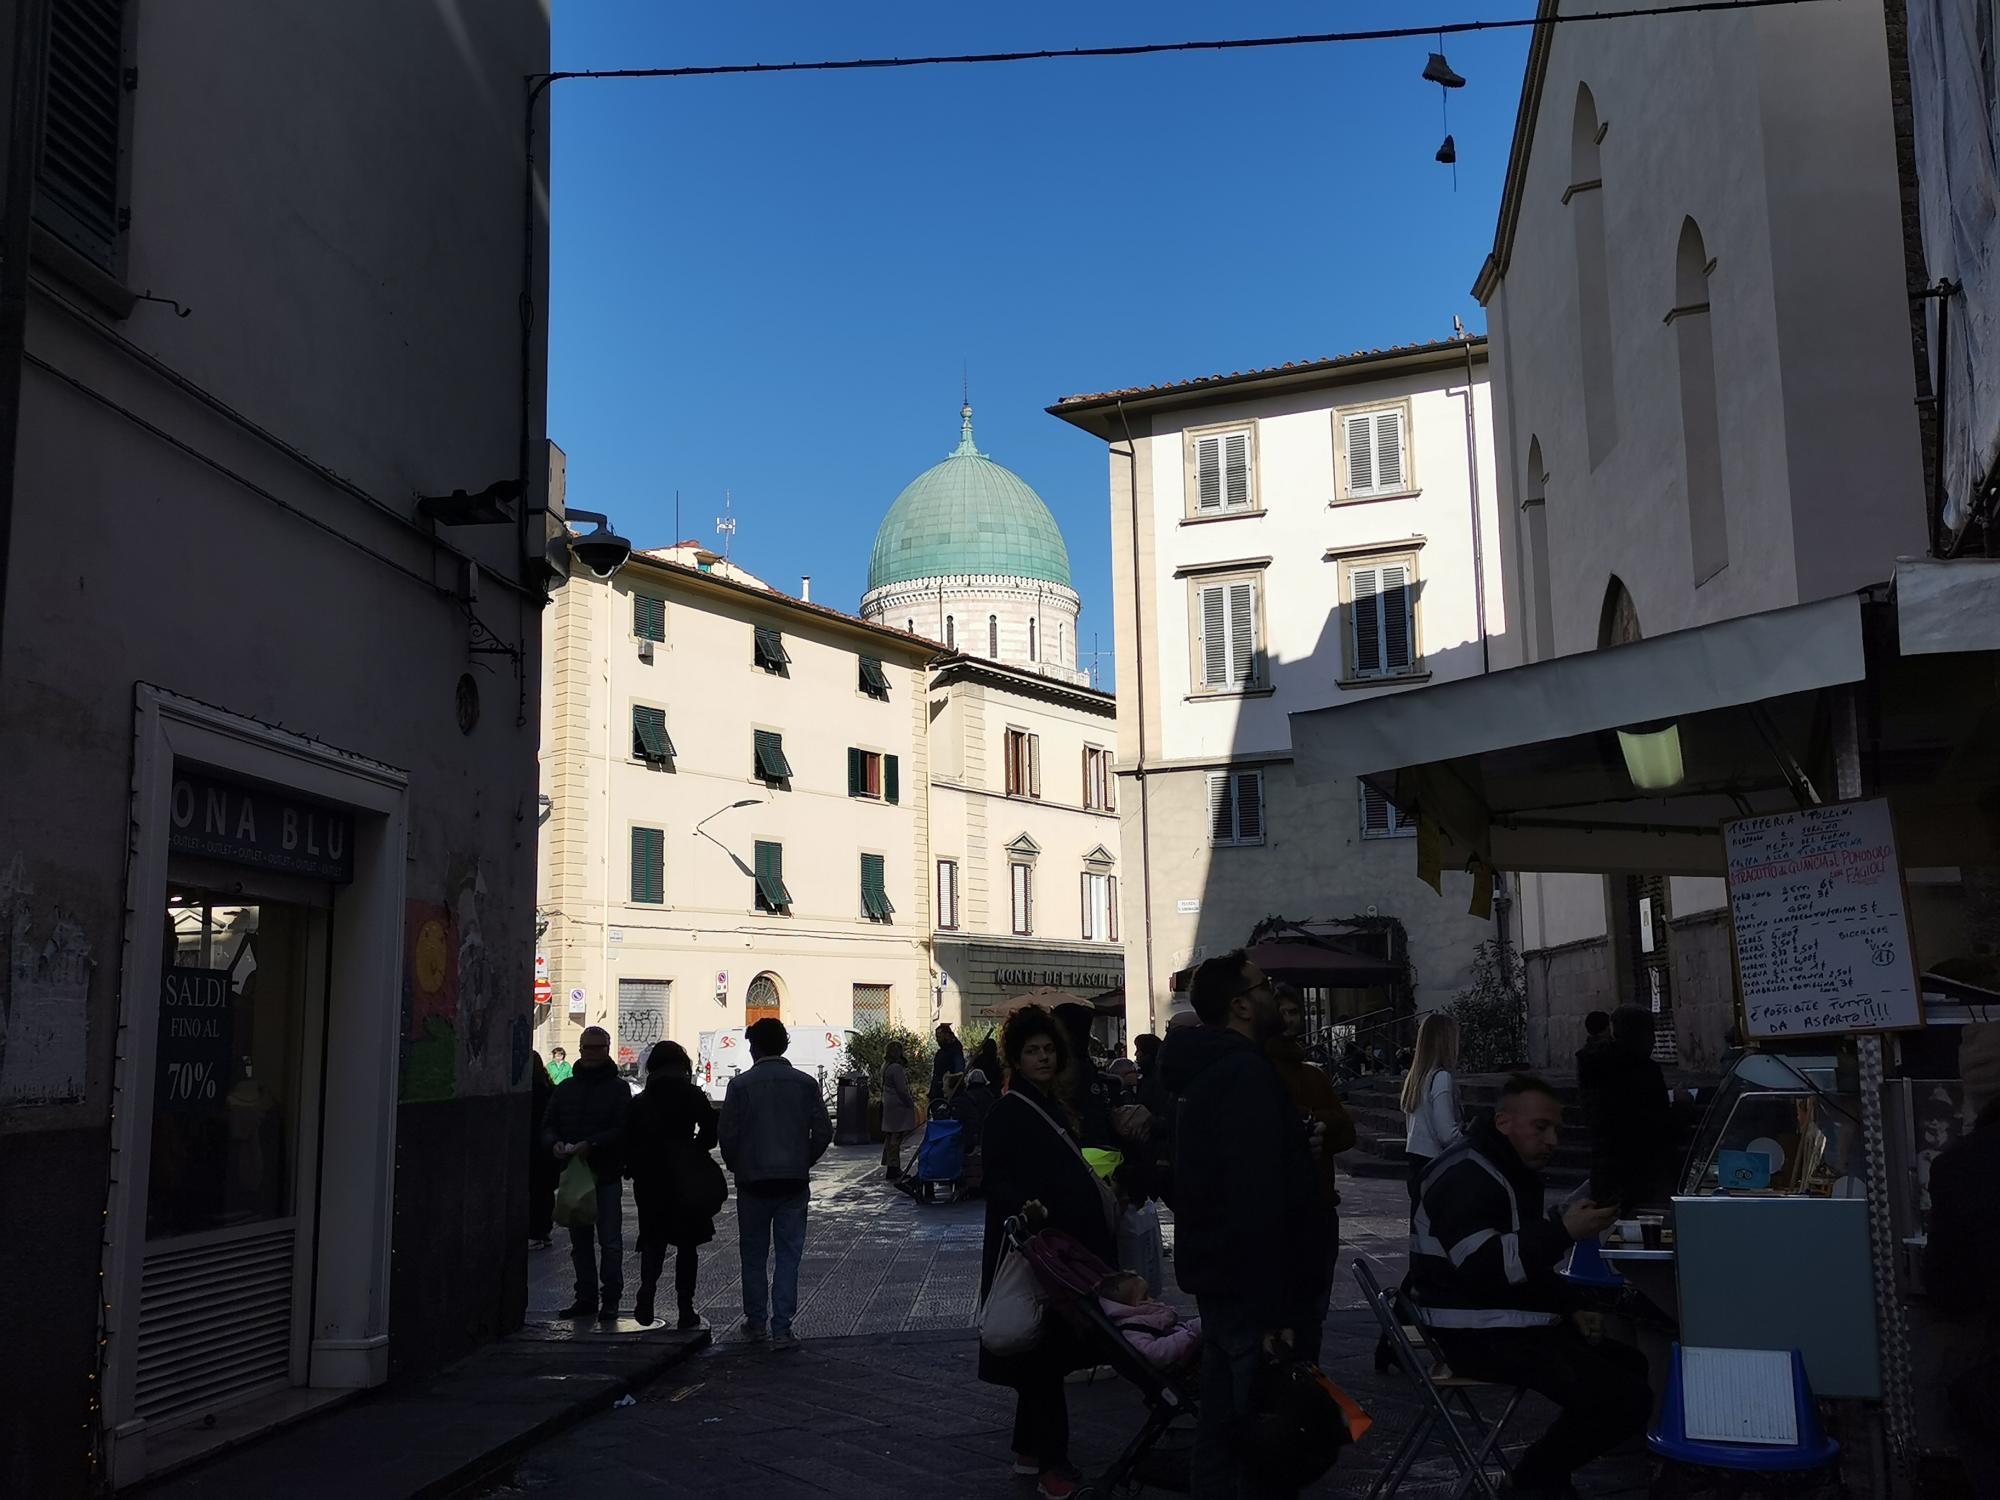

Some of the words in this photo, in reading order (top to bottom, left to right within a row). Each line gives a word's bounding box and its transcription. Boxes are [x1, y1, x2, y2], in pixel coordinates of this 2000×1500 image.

[281, 807, 345, 860] BLU
[166, 974, 227, 1008] SALDI
[997, 969, 1036, 985] MONTE
[1045, 971, 1065, 985] DEI
[1072, 972, 1111, 986] PASCHI
[169, 1017, 202, 1038] FINO
[202, 1018, 221, 1038] AL
[1769, 1021, 1788, 1033] DA
[168, 1061, 217, 1101] 70%
